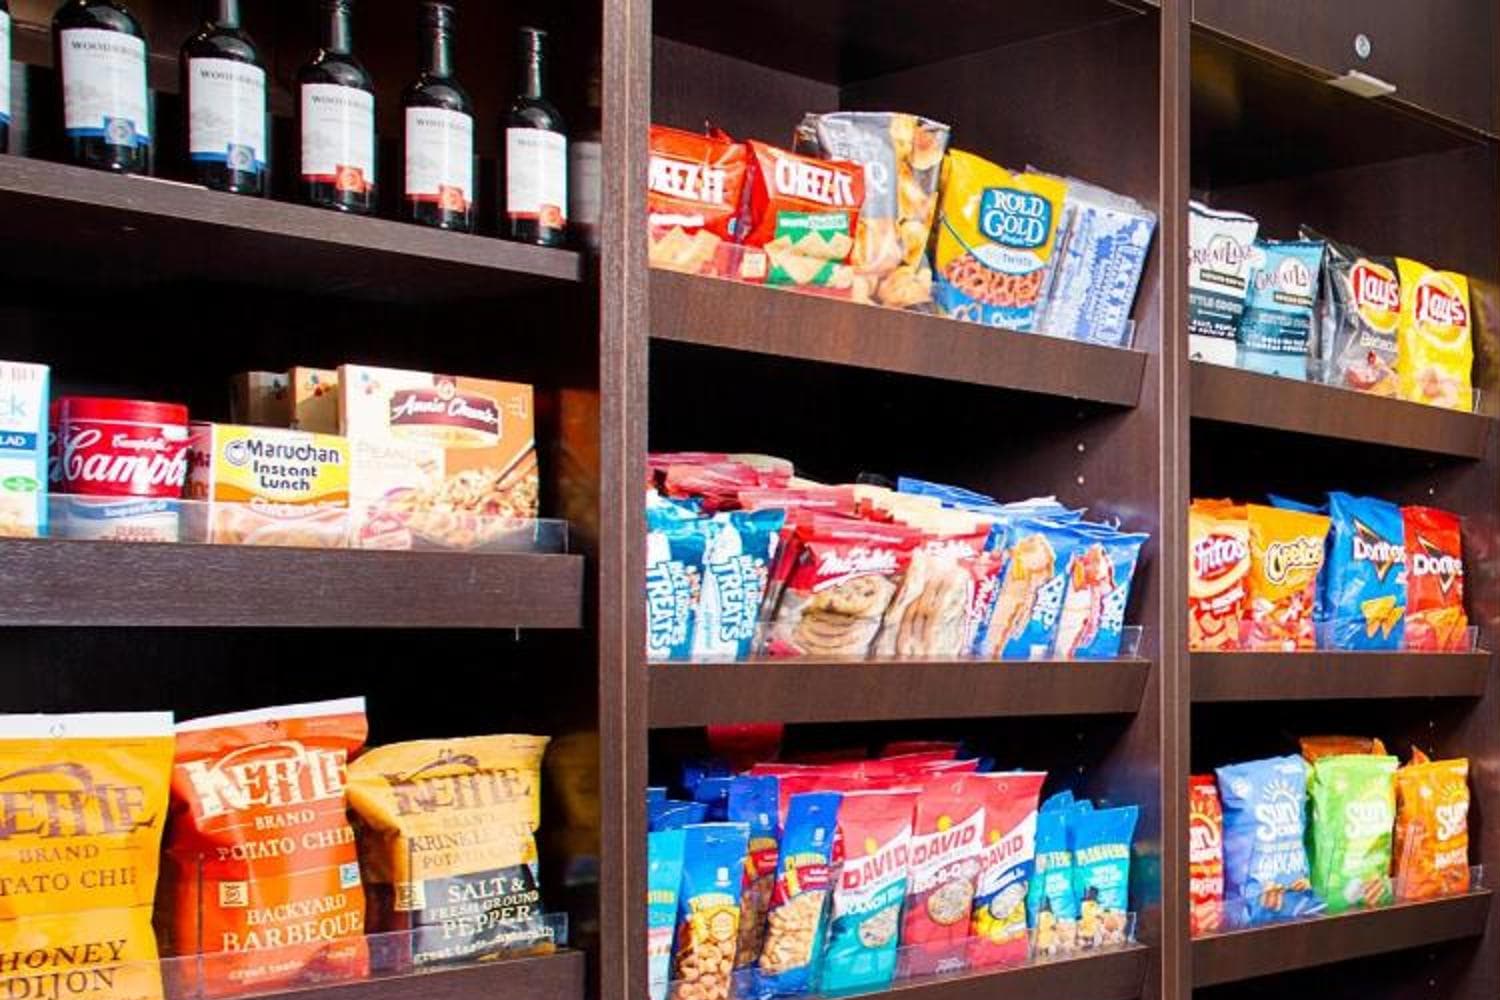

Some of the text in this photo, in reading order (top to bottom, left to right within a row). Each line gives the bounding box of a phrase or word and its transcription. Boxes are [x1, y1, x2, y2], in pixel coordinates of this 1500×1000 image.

[992, 190, 1044, 219] ROLD
[983, 210, 1045, 245] GOLD
[1418, 286, 1466, 322] Lay's
[246, 440, 340, 463] Maruchan
[253, 461, 318, 478] Instant
[260, 477, 311, 491] Lunch
[646, 563, 673, 648] TREATS
[711, 557, 743, 642] TREATS
[0, 782, 157, 841] ETTLE
[255, 809, 316, 830] BRAND
[19, 843, 100, 865] BRAND
[216, 836, 295, 862] POTATO
[911, 825, 977, 865] DAVID
[842, 843, 910, 889] DAVID
[0, 872, 71, 897] TATO
[447, 877, 526, 903] SALT &
[483, 889, 540, 912] GROUND
[246, 894, 348, 926] BACKYARD
[443, 904, 533, 939] PEPPER
[222, 910, 363, 954] BARBEQUE
[0, 938, 127, 974] HONEY
